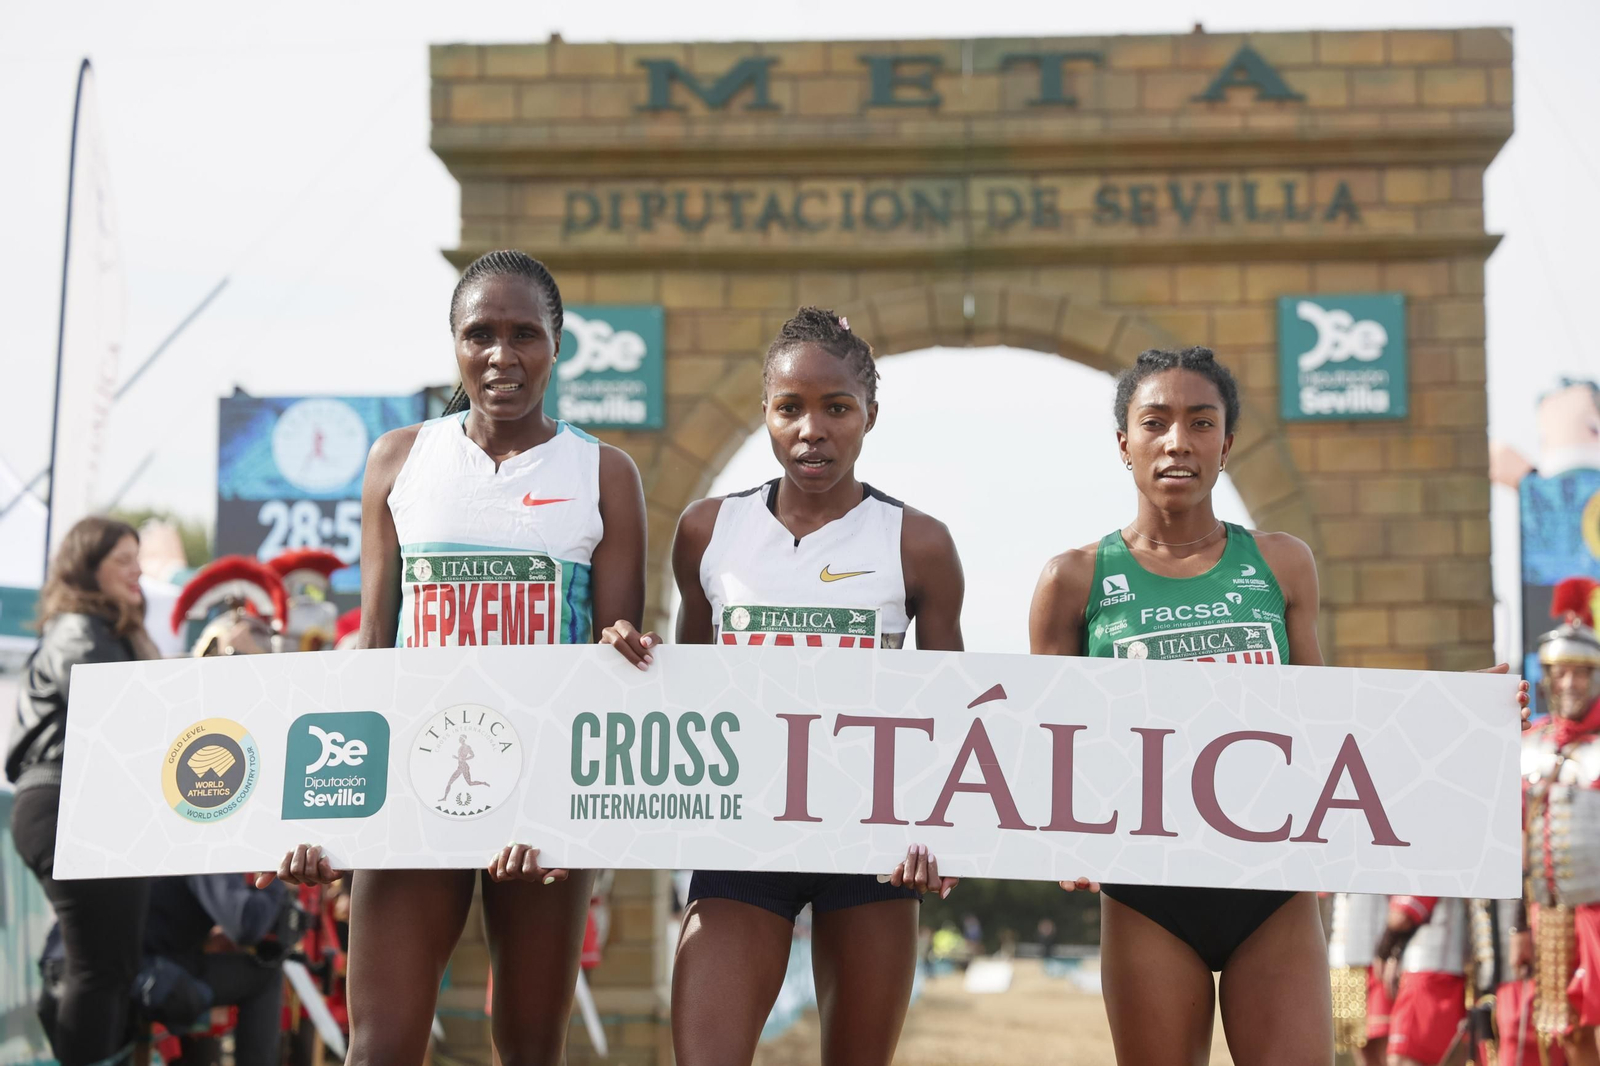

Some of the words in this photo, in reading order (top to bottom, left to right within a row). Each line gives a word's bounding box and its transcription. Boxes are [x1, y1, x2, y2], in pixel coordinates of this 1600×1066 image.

[635, 45, 1307, 112] META
[563, 181, 958, 237] DIPUTACION
[985, 185, 1063, 232] DE
[1091, 179, 1362, 227] SEVILLA
[557, 395, 648, 424] Sevilla
[1299, 386, 1390, 415] Sevilla
[441, 558, 516, 576] ITÁLICA
[761, 609, 836, 628] ITÁLICA
[1140, 600, 1232, 625] Facsa
[1158, 633, 1235, 655] ITÁLICA
[168, 740, 183, 764] GOLD
[182, 725, 206, 743] LEVEL
[419, 710, 513, 753] ITÁLICA
[571, 711, 740, 786] CROSS
[773, 683, 1411, 847] ITÁLICA
[186, 809, 212, 819] WORLD
[213, 801, 237, 818] CROSS
[236, 769, 256, 803] COUNTRY
[246, 746, 256, 767] TOUR
[187, 788, 230, 797] ATHLETICS
[195, 781, 224, 789] WORLD
[304, 775, 366, 790] Diputación
[303, 789, 365, 807] Sevilla
[570, 793, 714, 820] INTERNACIONAL
[720, 794, 743, 820] DE
